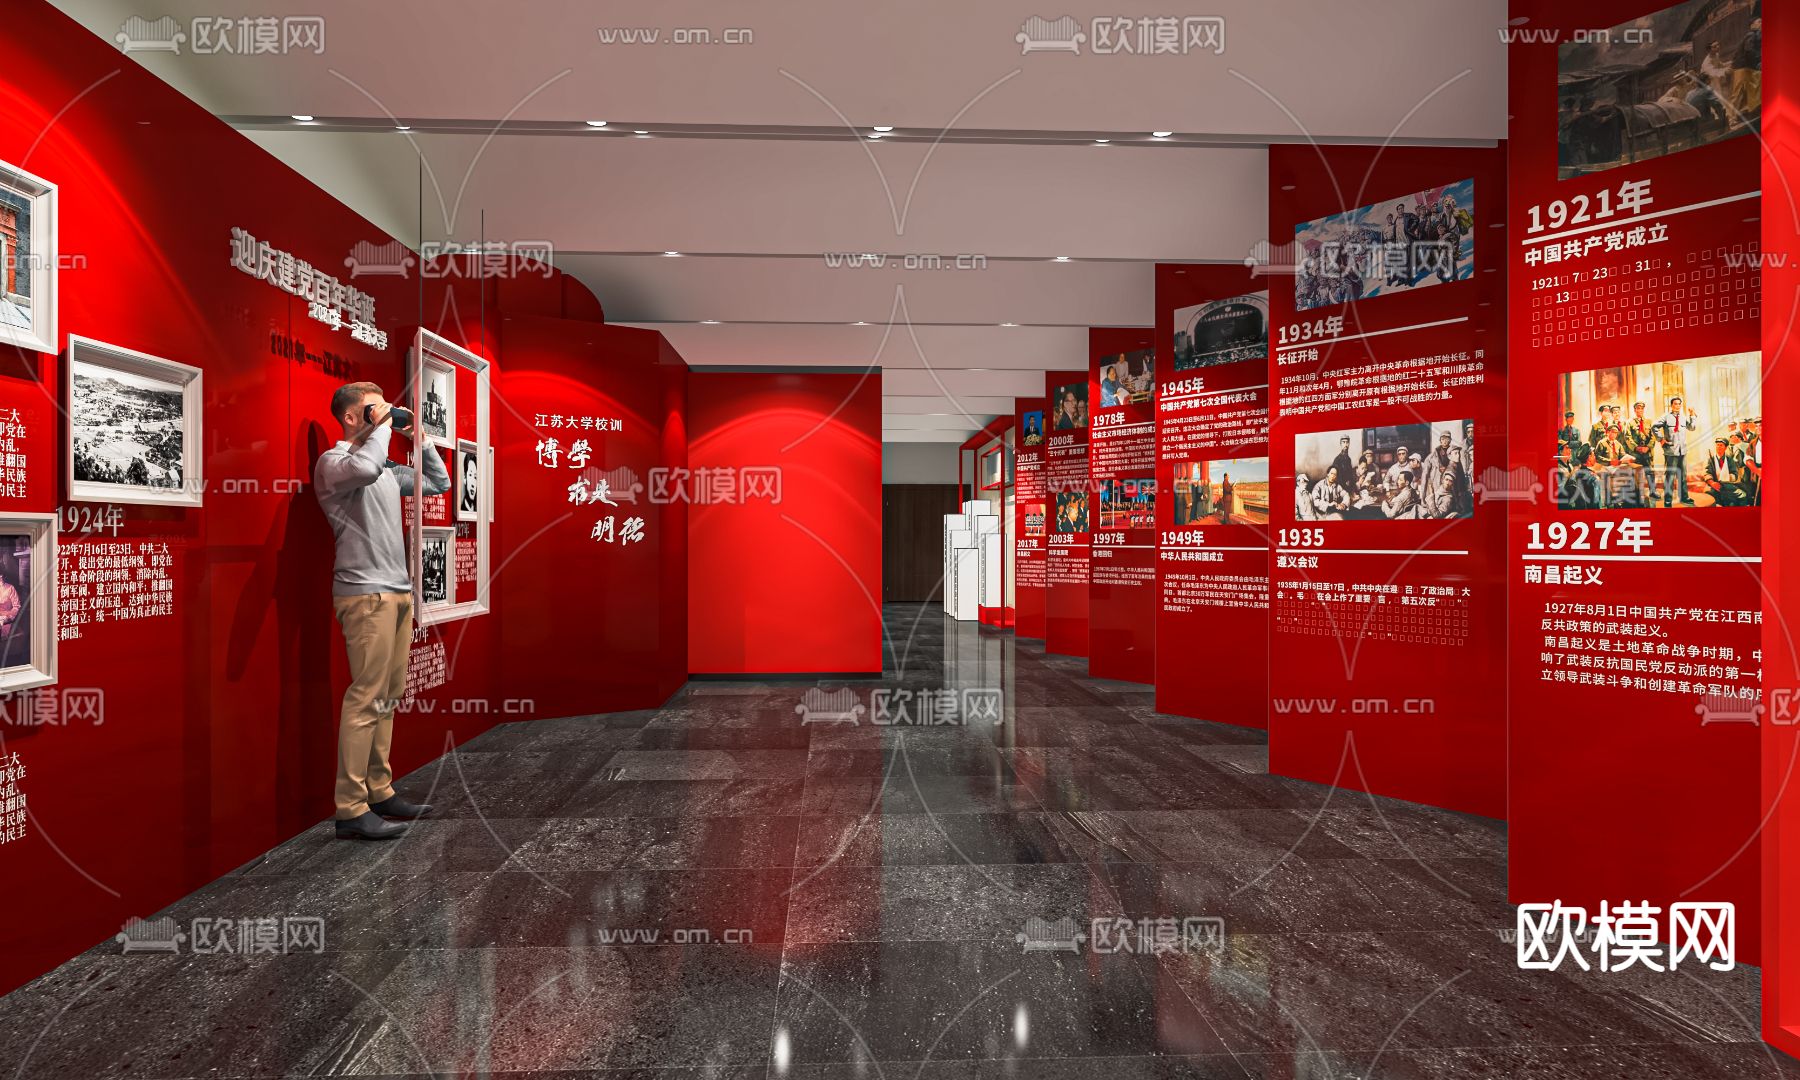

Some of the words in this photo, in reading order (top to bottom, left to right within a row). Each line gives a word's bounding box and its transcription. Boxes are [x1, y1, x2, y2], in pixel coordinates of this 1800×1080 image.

[1527, 178, 1653, 234] 1921年
[1524, 222, 1669, 267] 中国共产党成立
[230, 227, 376, 328] 迎庆建党百年华诞
[1278, 316, 1344, 344] 1934年
[1277, 348, 1319, 365] 长征开始
[1161, 377, 1204, 396] 1945年
[1160, 392, 1257, 412] 中国共产党第七次全国代表大会
[534, 413, 623, 432] 江苏大学校训
[1093, 412, 1125, 427] 1978年
[1048, 434, 1074, 446] 2000年
[1017, 452, 1038, 463] 2012年
[57, 504, 124, 537] 1924年
[1017, 539, 1038, 548] 2017年
[1048, 533, 1074, 544] 2003年
[1093, 532, 1125, 544] 1997年
[1161, 530, 1204, 546] 1949年
[1278, 528, 1325, 547] 1935
[1527, 517, 1654, 553] 1927年
[1160, 552, 1224, 561] 中华人民共和国成立
[1277, 556, 1318, 568] 遵义会议
[1524, 564, 1604, 585] 南昌起义
[58, 578, 173, 599] 倒军阀，建立国内和平；推翻国
[58, 591, 173, 612] 帝国主义的压迫，达到中华民族
[1541, 619, 1669, 638] 反共政策的武装起义。
